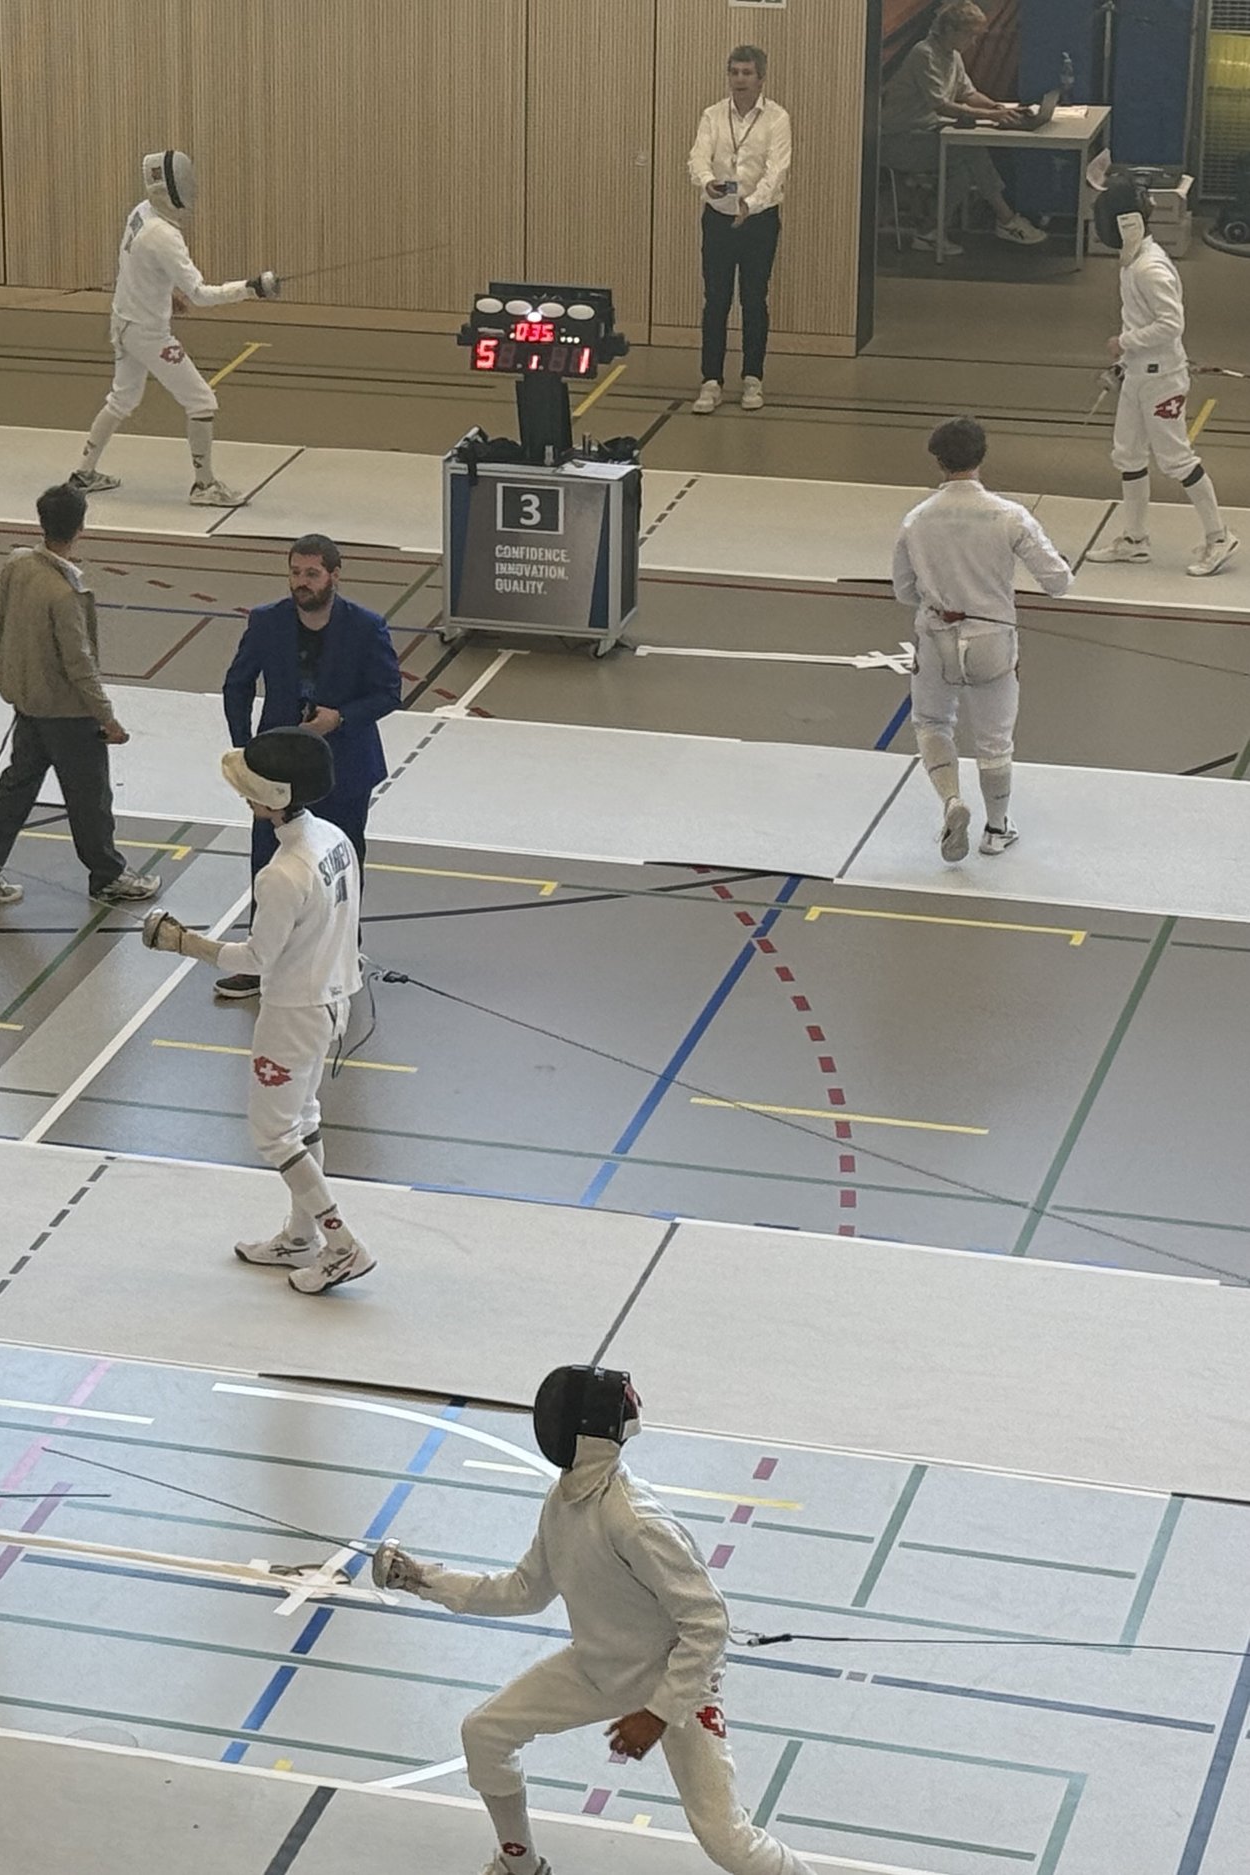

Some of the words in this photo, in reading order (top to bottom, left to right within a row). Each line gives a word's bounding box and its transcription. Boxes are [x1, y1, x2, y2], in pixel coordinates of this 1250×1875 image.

[476, 339, 498, 369] 5
[579, 347, 591, 374] 1
[519, 493, 542, 526] 3
